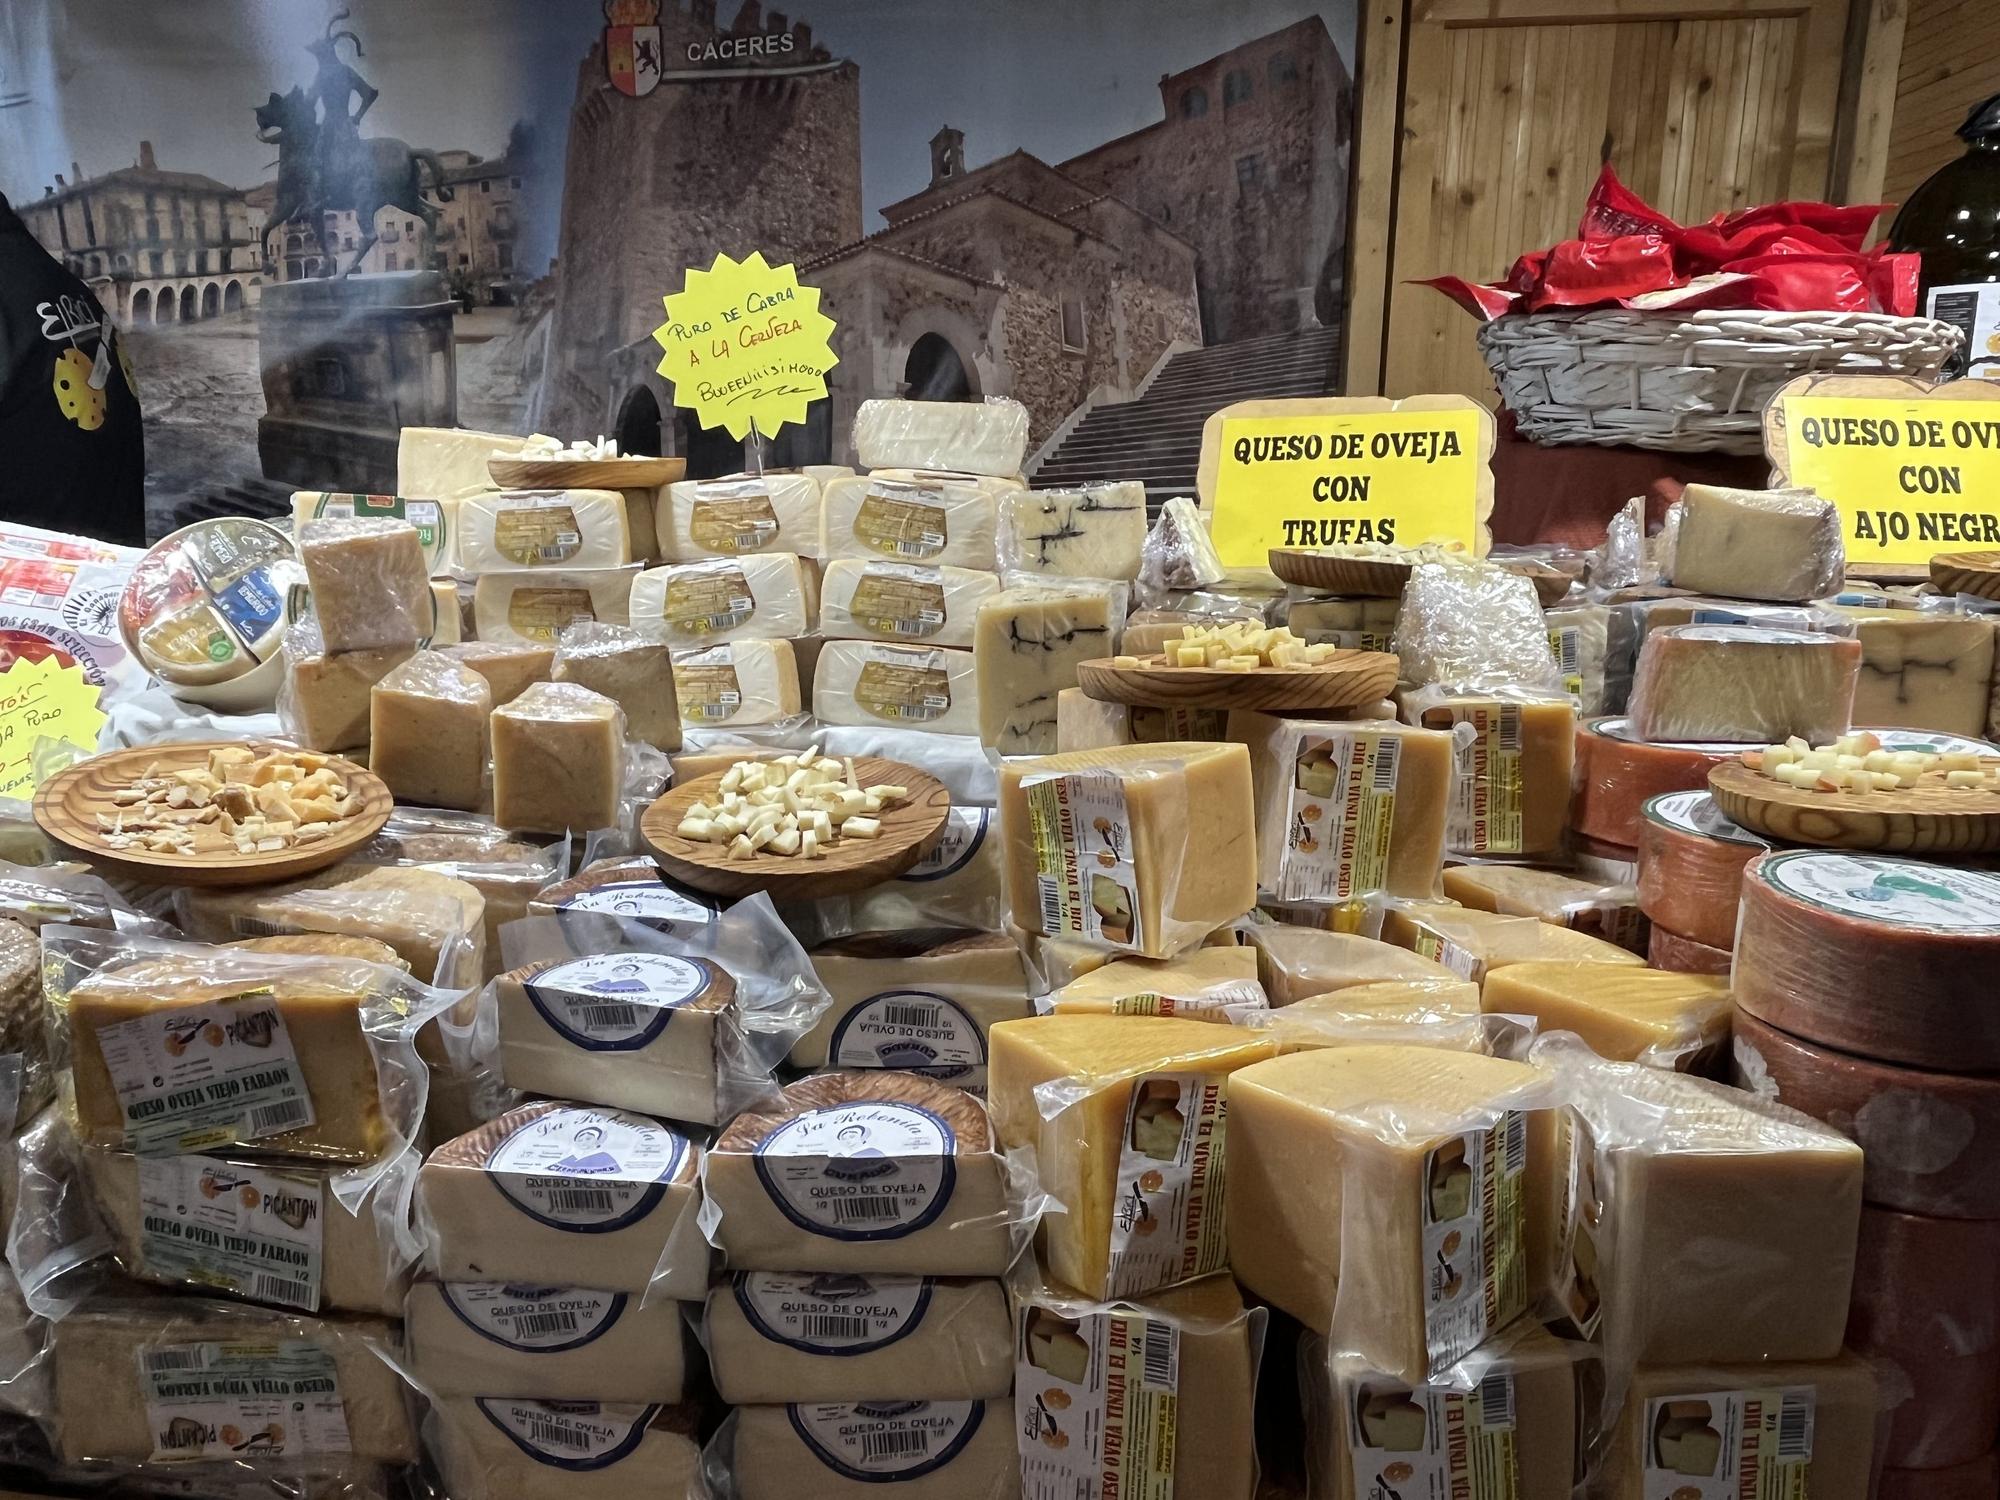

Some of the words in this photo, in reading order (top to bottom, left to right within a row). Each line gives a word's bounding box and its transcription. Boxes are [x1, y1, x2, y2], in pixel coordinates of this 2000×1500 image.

[667, 322, 712, 341] PURO
[720, 307, 742, 323] DE
[747, 287, 795, 314] CABRA
[690, 350, 700, 367] A
[711, 339, 730, 358] LA
[739, 315, 802, 348] CERVEZA
[1801, 417, 1900, 448] QUESO
[1908, 420, 1946, 448] DE
[1233, 434, 1323, 465] QUESO
[1328, 433, 1365, 460] DE
[1371, 431, 1462, 464] OVEJA
[1312, 475, 1371, 503] CON
[1899, 465, 1962, 494] CON
[1282, 518, 1396, 546] TRUFAS
[1854, 510, 1910, 547] AJO
[24, 708, 61, 726] PURO
[1352, 742, 1367, 765] BICI
[1367, 753, 1375, 769] 1/4
[1351, 768, 1363, 781] EL
[1346, 785, 1361, 821] TINAJA
[1342, 826, 1356, 859] OVEJA
[1338, 861, 1351, 897] QUESO
[1069, 890, 1081, 903] EL
[1061, 902, 1069, 918] 1/4
[1070, 906, 1082, 931] BICI
[860, 1023, 896, 1036] OVEJA
[900, 1028, 914, 1036] DE
[917, 1030, 956, 1041] QUESO
[128, 1099, 165, 1120] QUESO
[167, 1087, 206, 1110] OVEJA
[206, 1082, 241, 1101] VIEJO
[1201, 1084, 1219, 1115] BICI
[797, 1120, 827, 1137] La
[1198, 1119, 1214, 1136] EL
[1191, 1140, 1210, 1191] TINAJA
[810, 1186, 857, 1197] QUESO
[861, 1186, 879, 1195] DE
[882, 1184, 927, 1195] OVEJA
[263, 1194, 318, 1220] PICANTON
[816, 1201, 828, 1210] 1/2
[905, 1199, 918, 1207] 1/2
[1185, 1196, 1203, 1241] OVEJA
[144, 1215, 182, 1237] QUESO
[185, 1224, 220, 1247] OVEJA
[223, 1234, 258, 1256] VIEJO
[294, 1269, 309, 1282] 1/2
[490, 1304, 535, 1317] QUESO
[538, 1301, 557, 1312] DE
[559, 1300, 601, 1311] OVEJA
[780, 1302, 829, 1313] QUESO
[832, 1304, 850, 1314] DE
[854, 1305, 899, 1318] OVEJA
[785, 1315, 798, 1324] 1/2
[1110, 1319, 1128, 1350] BICI
[1131, 1337, 1143, 1357] 1/4
[1109, 1354, 1127, 1370] EL
[1106, 1374, 1127, 1419] TINAJA
[1446, 1407, 1465, 1423] EL
[1743, 1400, 1762, 1429] BICI
[1766, 1413, 1777, 1432] 1/4
[575, 1421, 616, 1438] OVEJA
[839, 1423, 885, 1434] QUESO
[889, 1420, 908, 1431] DE
[910, 1417, 955, 1430] OVEJA
[1103, 1428, 1124, 1468] OVEJA
[1447, 1426, 1468, 1474] TINAJA
[1742, 1434, 1760, 1450] EL
